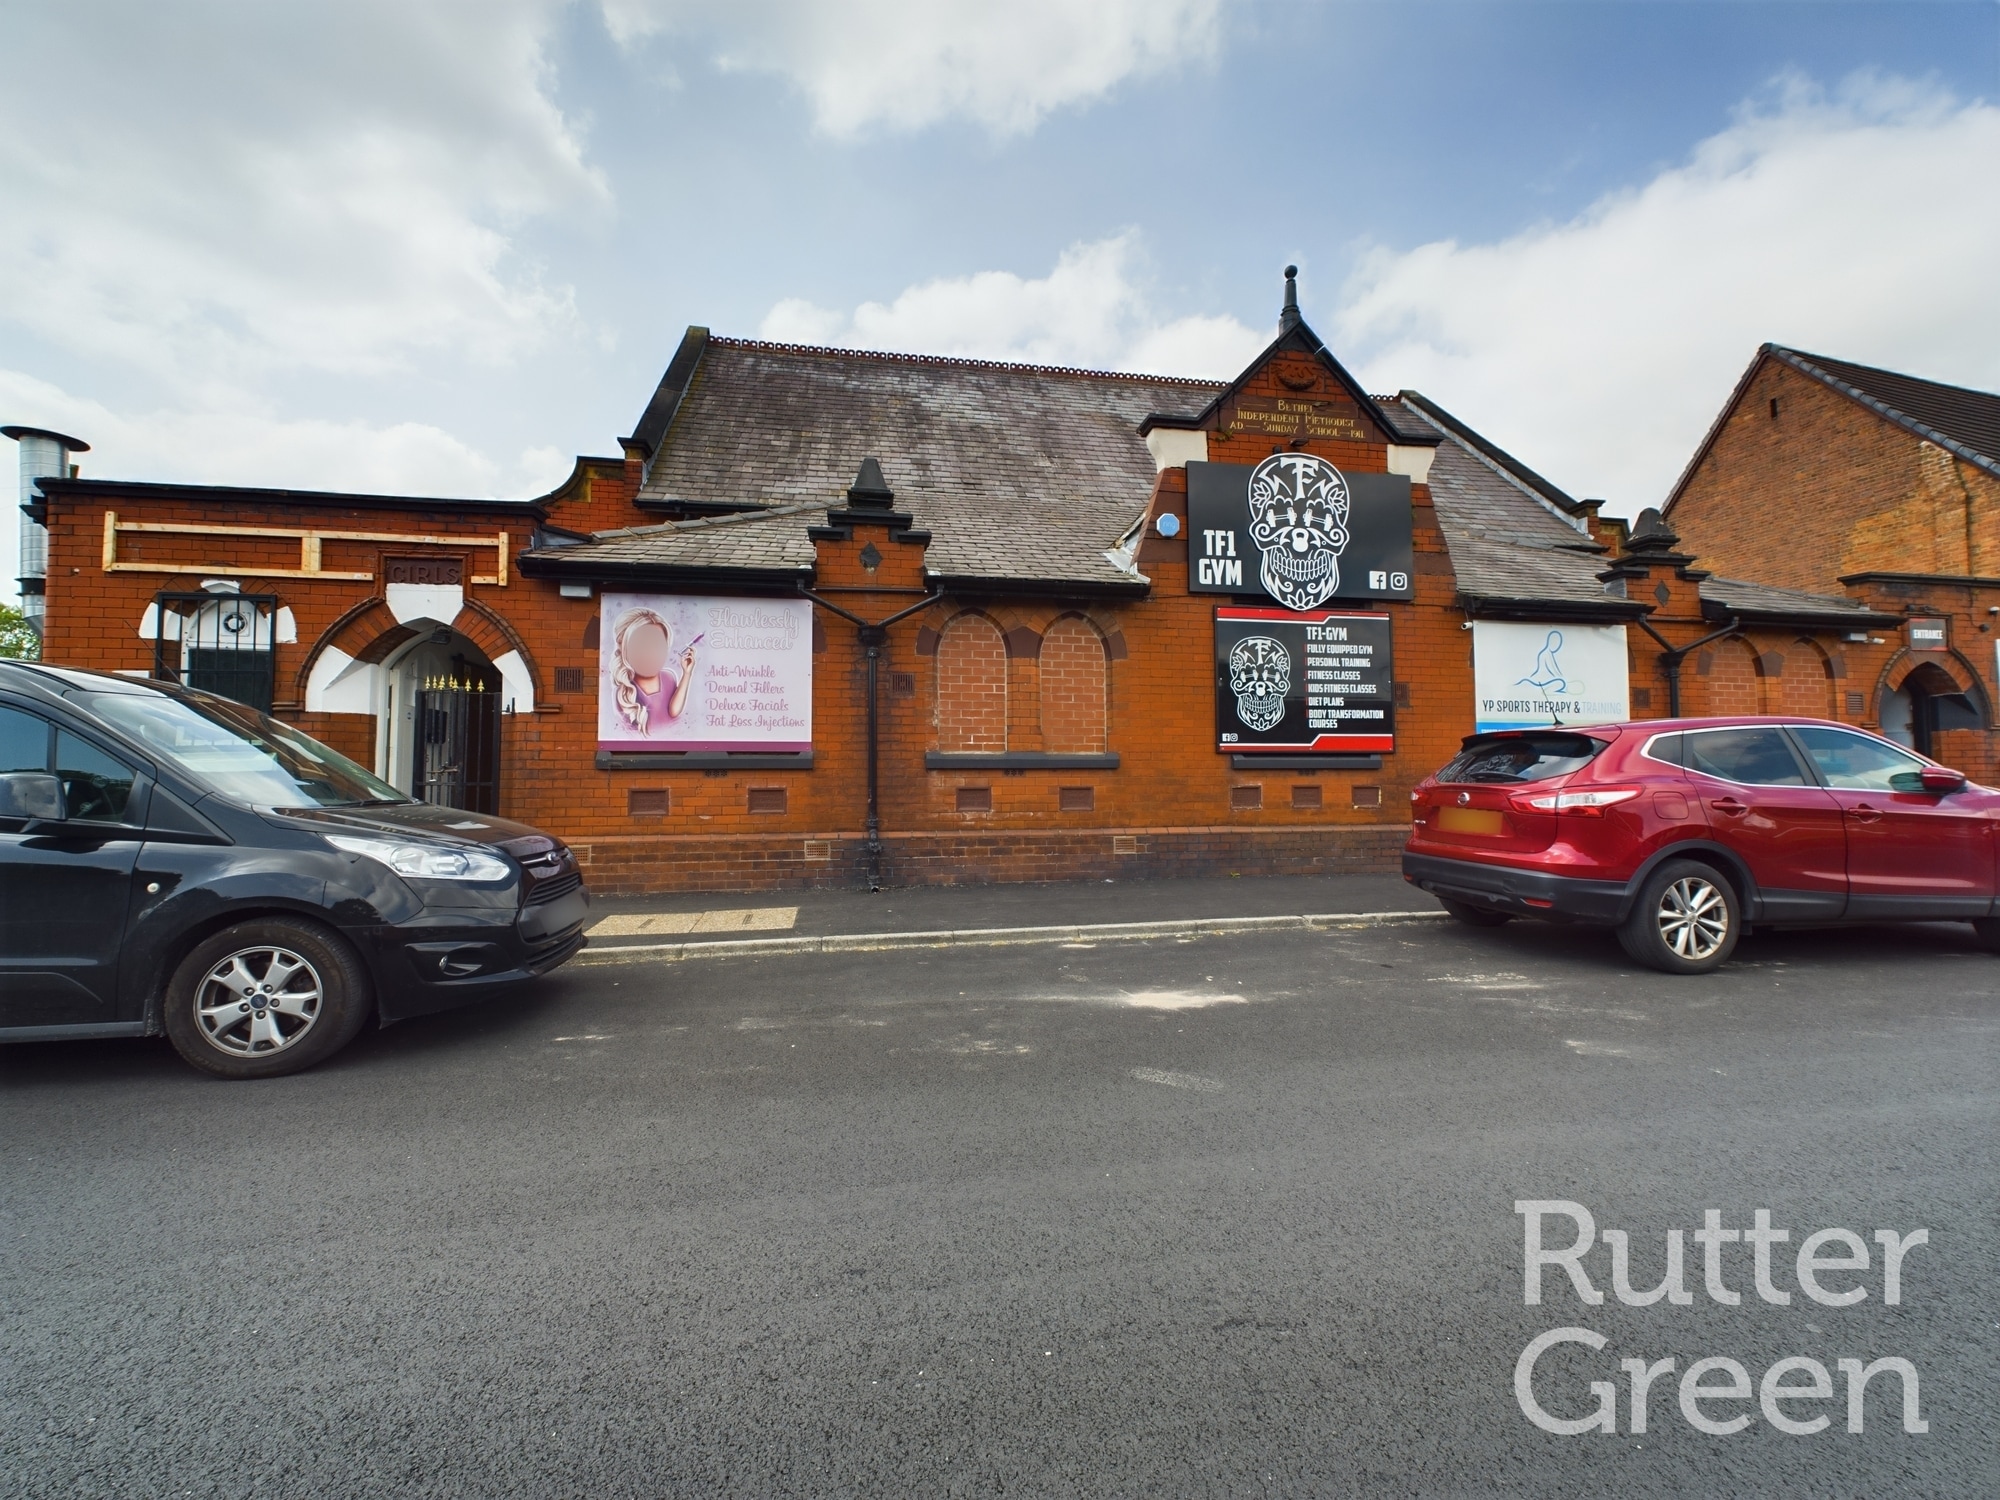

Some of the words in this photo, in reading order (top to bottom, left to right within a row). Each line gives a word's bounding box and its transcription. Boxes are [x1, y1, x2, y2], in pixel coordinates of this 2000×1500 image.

[1203, 529, 1237, 557] TF1
[392, 565, 460, 584] GIRLS
[1198, 558, 1242, 586] GYM
[708, 606, 800, 639] Flawlessly
[710, 629, 794, 650] Enhanced
[1306, 626, 1347, 641] TF1-GYM
[1913, 629, 1943, 639] ENTRANCE
[1307, 643, 1326, 653] FULLY
[1326, 645, 1358, 654] EQUIPPED
[1358, 645, 1373, 654] GYM
[1307, 657, 1341, 667] PERSONAL
[1341, 658, 1371, 667] TRAINING
[705, 665, 776, 678] Anti-Wrinkle
[1307, 670, 1333, 680] FITNESS
[1333, 670, 1361, 680] CLASSES
[704, 680, 747, 693] Dermal
[750, 681, 784, 694] Fillers
[1308, 683, 1324, 693] KIDS
[1324, 684, 1350, 693] FITNESS
[1349, 684, 1377, 693] CLASSES
[705, 698, 746, 711] Deluxe
[749, 698, 789, 712] Facials
[1308, 697, 1322, 706] DIET
[1323, 697, 1345, 706] PLANS
[1482, 699, 1495, 712] YP
[1496, 700, 1531, 713] SPORTS
[1533, 701, 1572, 714] THERAPY
[1573, 702, 1580, 713] &
[1582, 703, 1622, 715] TRAINING
[1308, 709, 1327, 719] BODY
[1327, 709, 1384, 719] TRANSFORMATION
[705, 714, 725, 727] Fat
[727, 714, 752, 728] Loss
[754, 714, 805, 732] Injections
[1308, 719, 1338, 728] COURSES
